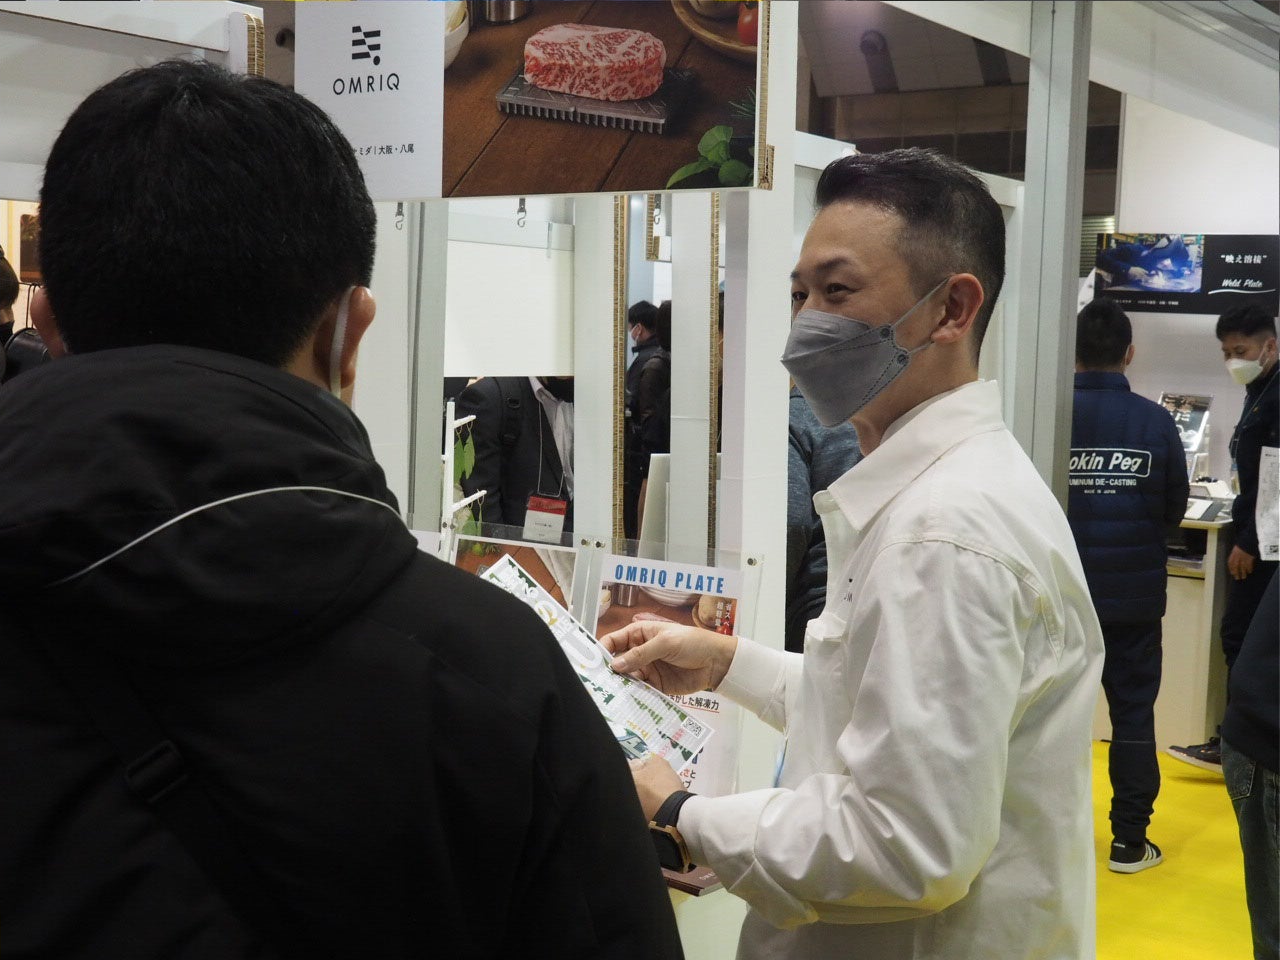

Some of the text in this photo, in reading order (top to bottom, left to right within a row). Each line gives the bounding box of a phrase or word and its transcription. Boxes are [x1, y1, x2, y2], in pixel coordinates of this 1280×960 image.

[332, 72, 400, 96] OMRIQ
[1108, 452, 1143, 472] Peg
[614, 564, 725, 594] OMRIQ PLATE
